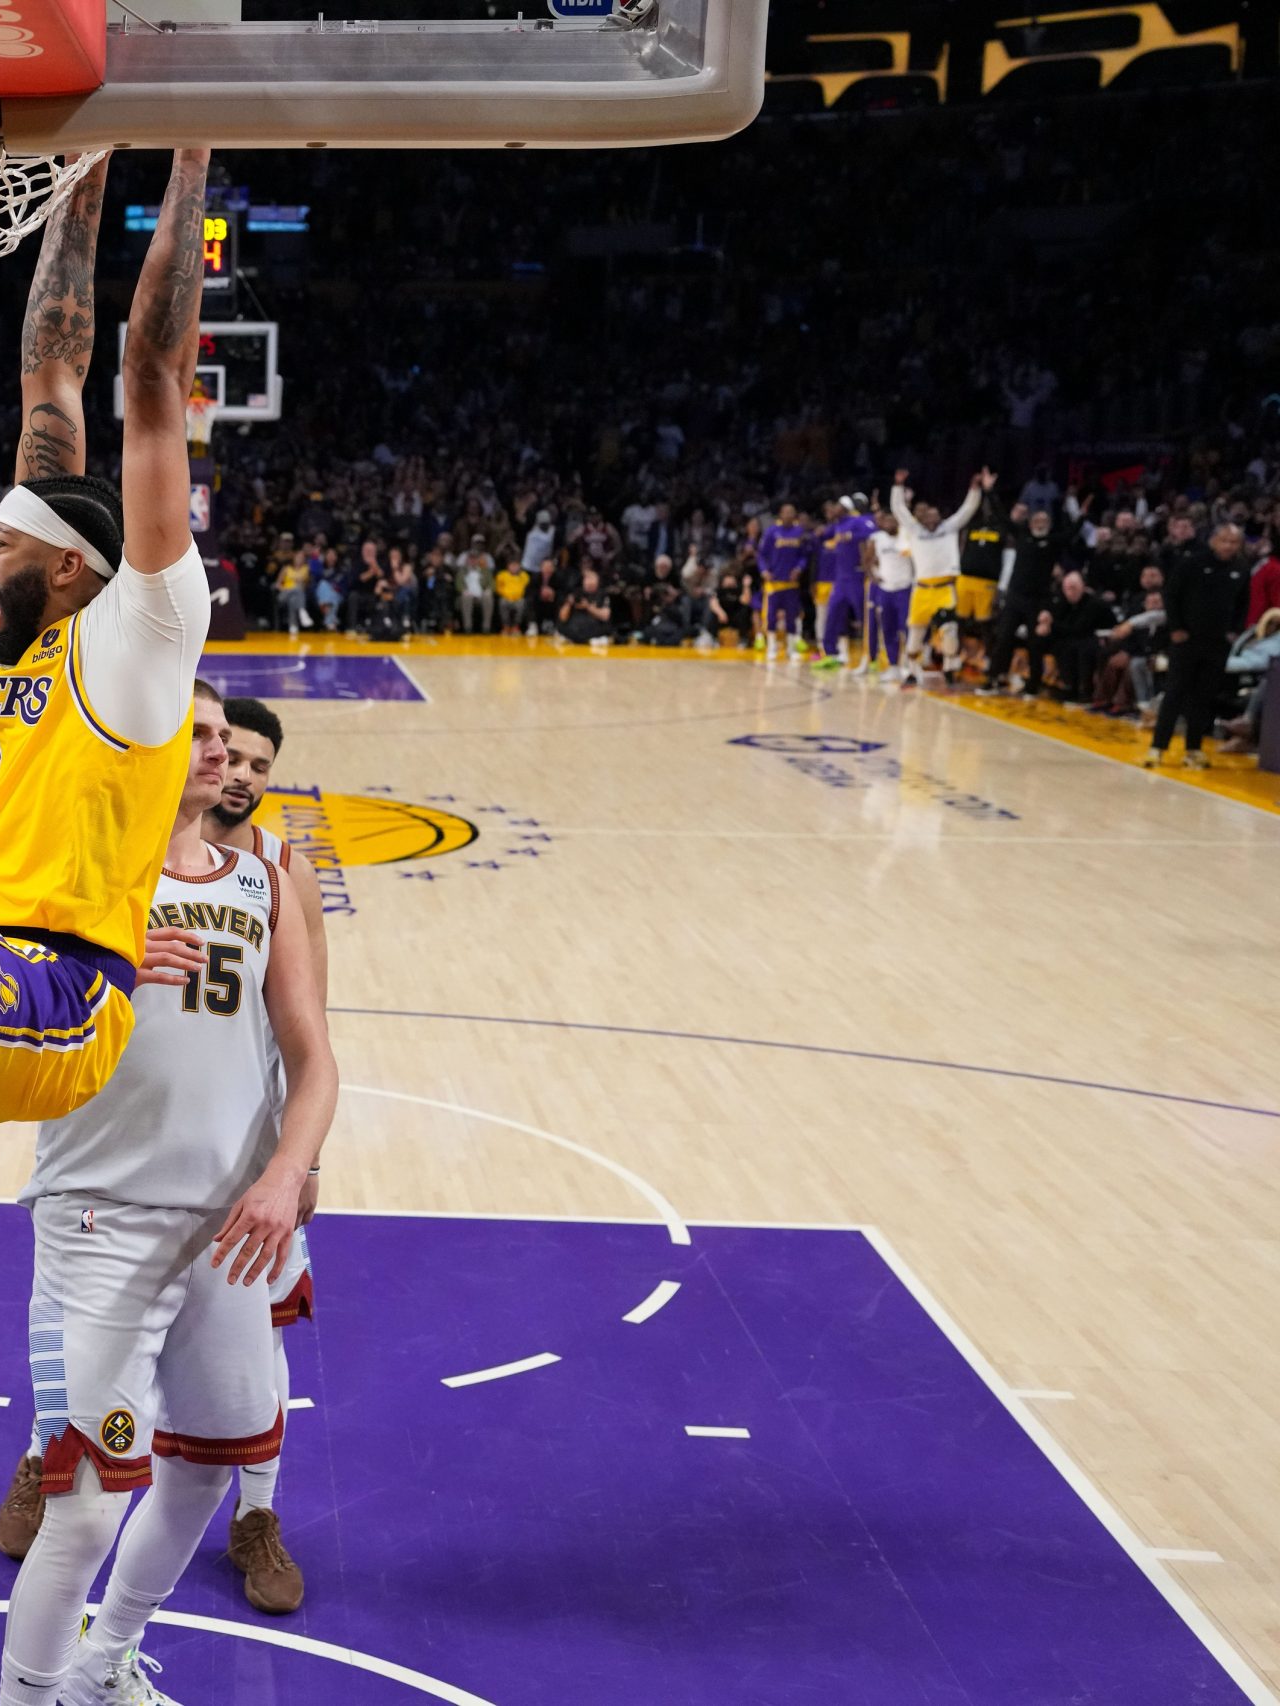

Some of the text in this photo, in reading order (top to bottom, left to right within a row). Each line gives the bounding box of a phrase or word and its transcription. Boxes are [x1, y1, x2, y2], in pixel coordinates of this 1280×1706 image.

[32, 645, 63, 663] bibigo
[237, 874, 265, 889] WU
[239, 887, 267, 896] Western
[245, 892, 265, 900] Union
